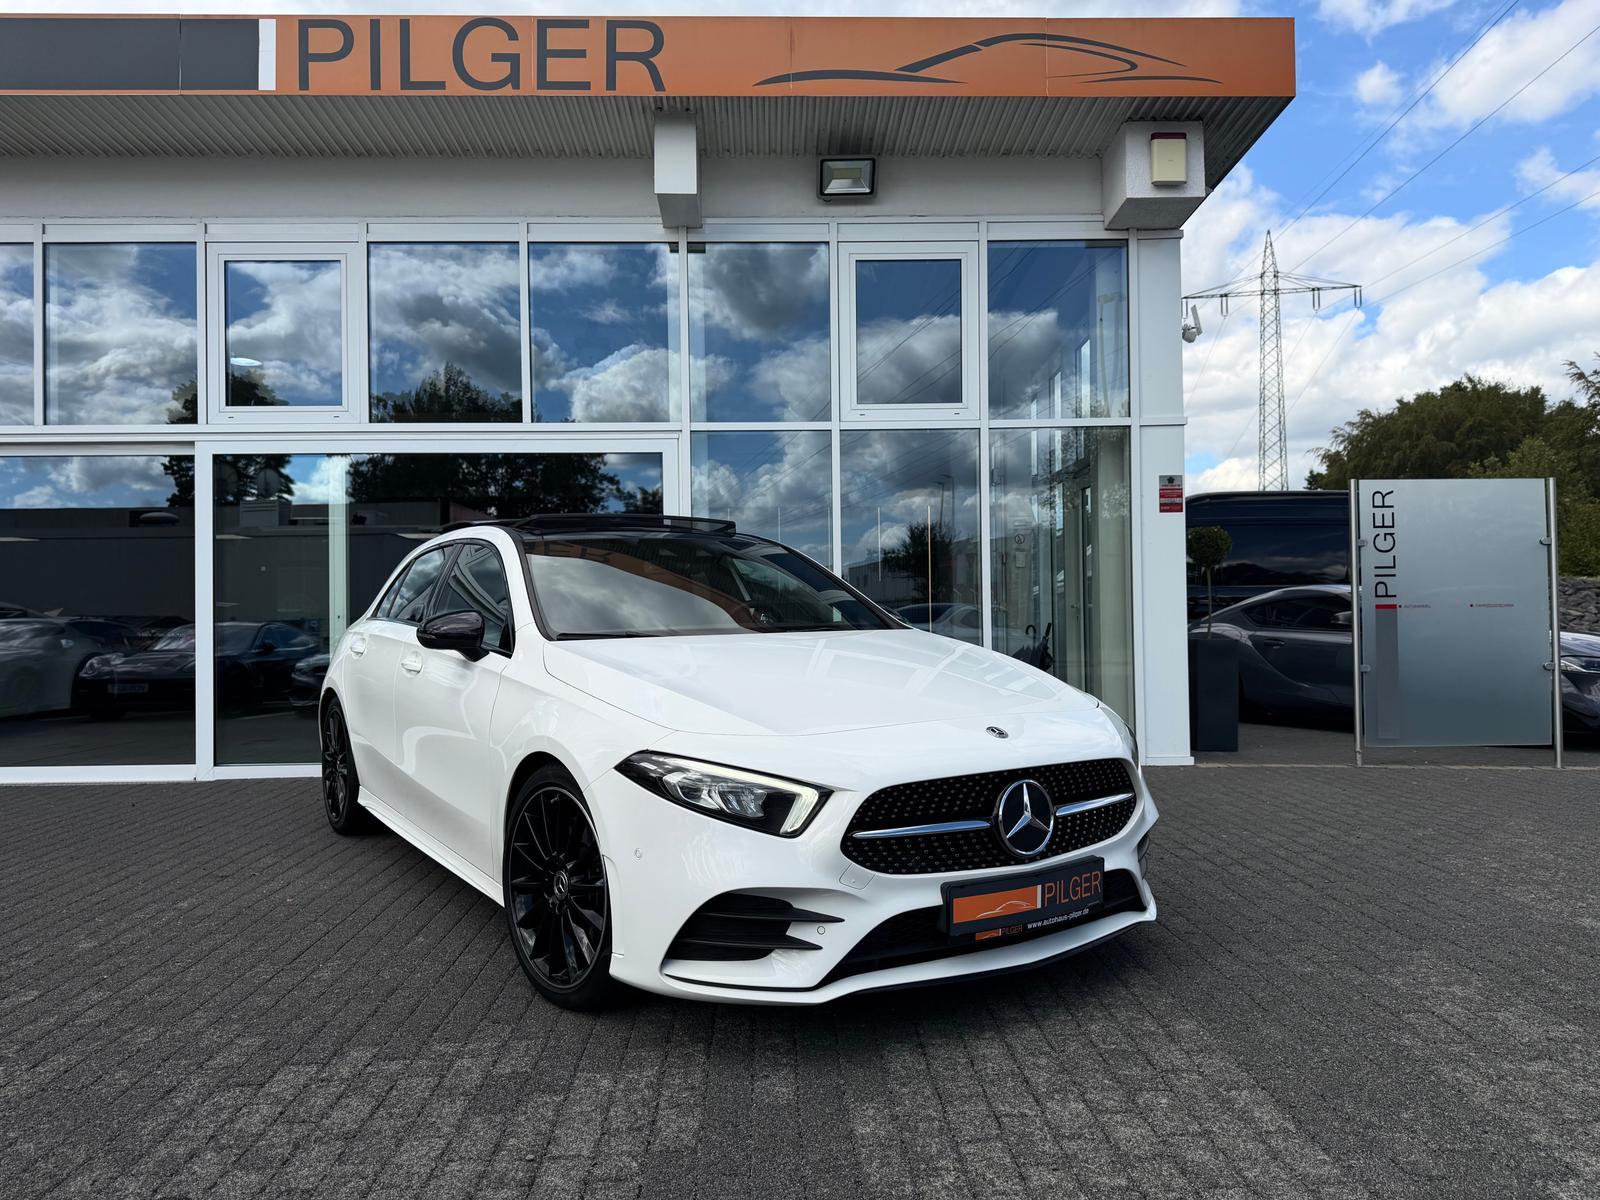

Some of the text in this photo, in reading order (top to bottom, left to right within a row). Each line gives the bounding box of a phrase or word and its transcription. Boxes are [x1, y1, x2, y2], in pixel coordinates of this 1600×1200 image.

[298, 17, 666, 92] PILGER
[1372, 490, 1397, 598] PILGER
[1044, 871, 1102, 907] PILGER
